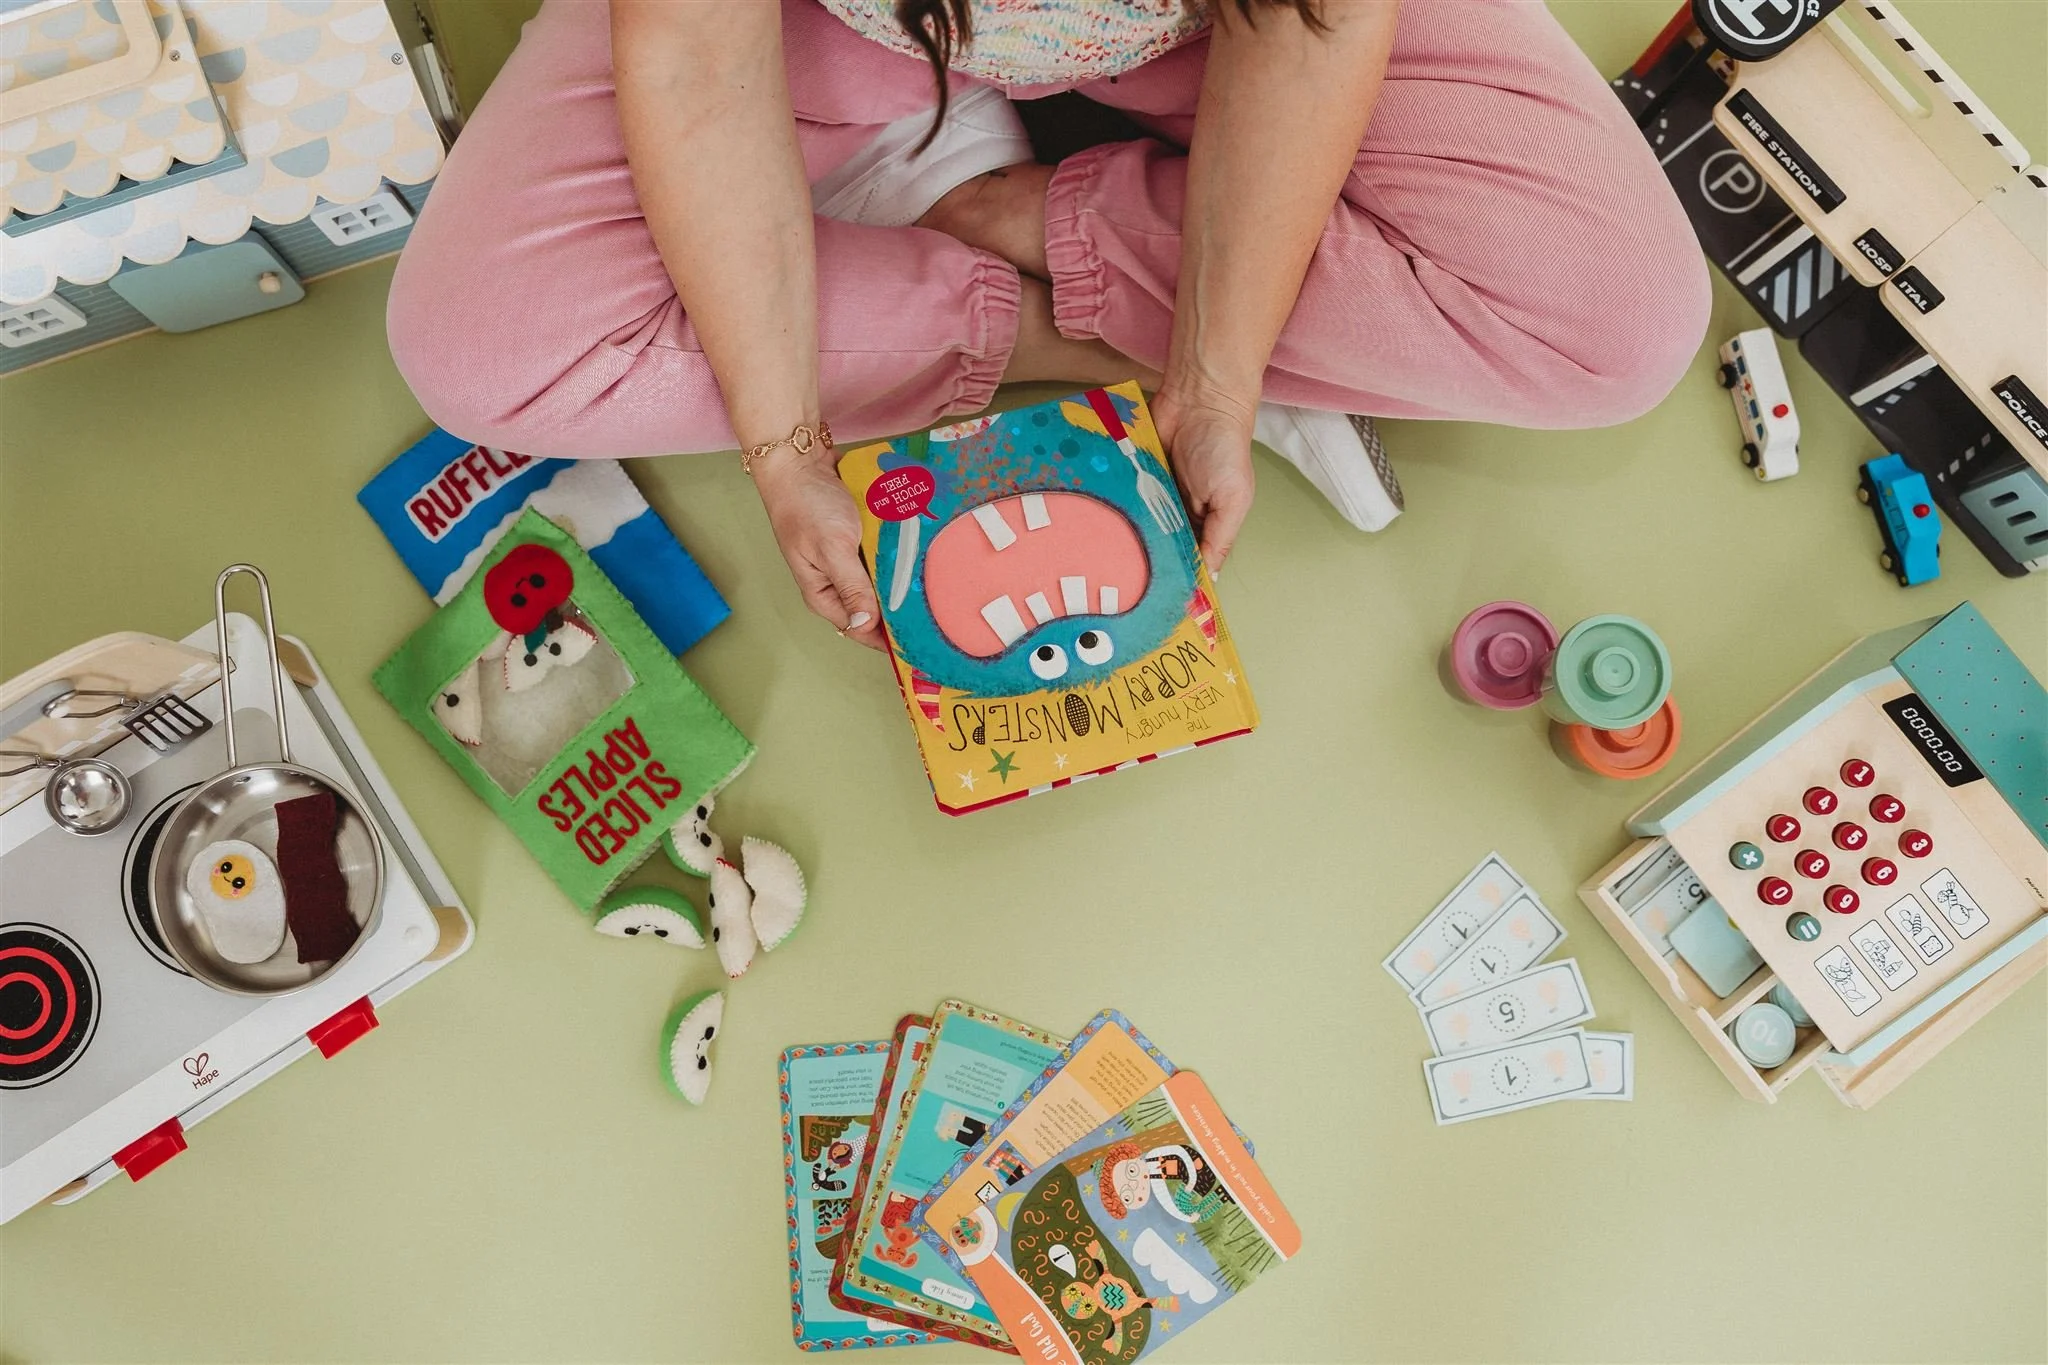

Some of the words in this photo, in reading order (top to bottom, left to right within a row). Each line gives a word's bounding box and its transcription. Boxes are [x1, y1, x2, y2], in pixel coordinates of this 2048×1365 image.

[1742, 112, 1769, 142] FIRE
[1767, 140, 1822, 197] STATION
[1709, 162, 1756, 195] P
[1857, 239, 1893, 274] HOSP
[1899, 280, 1929, 311] ITAL
[2000, 390, 2047, 438] POLICE
[880, 473, 911, 493] FEEL
[891, 481, 930, 504] TOUCH
[873, 497, 890, 511] and
[1123, 640, 1216, 711] WORRY
[1183, 685, 1225, 713] VERY
[948, 686, 1124, 752] MONSTERS
[1125, 705, 1181, 745] hungry
[1187, 716, 1211, 733] The
[1901, 706, 1962, 773] 0000.00
[537, 716, 652, 833] APPLES
[1855, 766, 1869, 781] 1
[575, 760, 682, 866] SLICED
[1818, 796, 1831, 810] 4
[1885, 803, 1899, 818] 2
[1847, 830, 1863, 844] 5
[1912, 839, 1928, 851] 3
[1809, 858, 1825, 873] 8
[1877, 866, 1892, 879] 6
[1773, 886, 1788, 899] 0
[1839, 894, 1853, 908] 9
[1452, 923, 1468, 940] 1
[1480, 958, 1496, 974] 1
[1499, 1001, 1515, 1024] 5
[1751, 1019, 1779, 1047] 10
[192, 1069, 219, 1089] Hape
[1505, 1065, 1517, 1086] 1
[1020, 1311, 1044, 1338] Owl
[1036, 1334, 1060, 1361] Old
